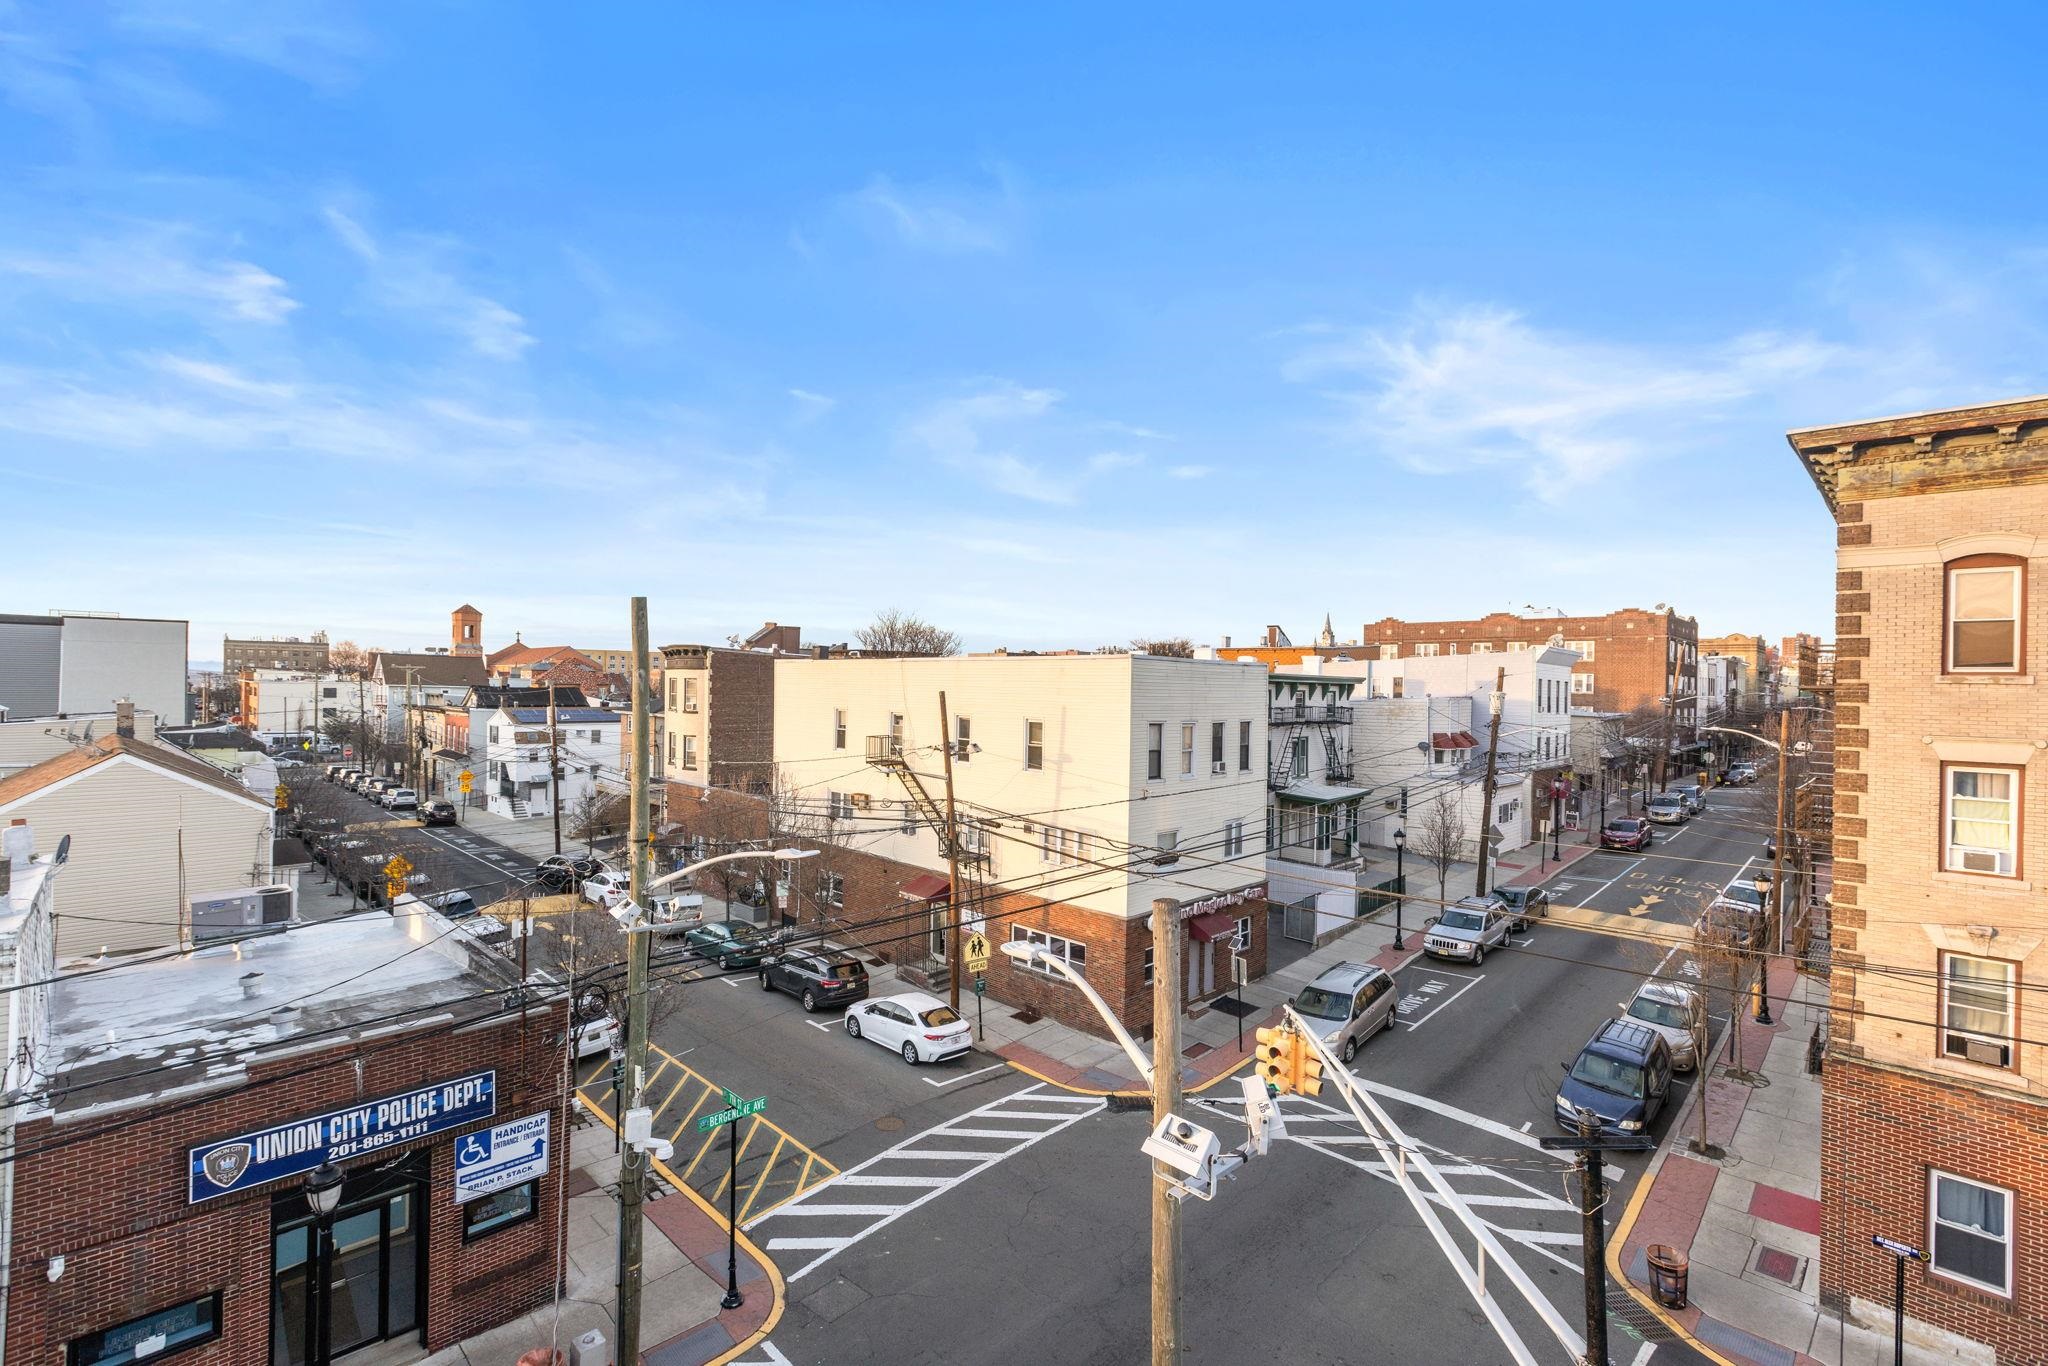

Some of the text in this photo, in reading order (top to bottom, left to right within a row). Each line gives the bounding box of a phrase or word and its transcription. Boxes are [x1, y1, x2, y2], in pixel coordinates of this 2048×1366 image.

[971, 961, 986, 971] AHEAD
[1417, 979, 1450, 994] WAY
[256, 1078, 486, 1164] UNION CITY POLICE DEPT.
[709, 1103, 751, 1127] BERGENLNE
[753, 1098, 766, 1112] AVE
[493, 1135, 519, 1150] ENTRANCE
[523, 1128, 545, 1141] ENTRADA
[495, 1117, 546, 1140] HANDICAP
[328, 1120, 428, 1160] 201-865-1111
[209, 1145, 245, 1160] UNION CITY
[216, 1169, 239, 1181] POLICE
[467, 1177, 495, 1191] BRIAN
[506, 1164, 534, 1179] STACK
